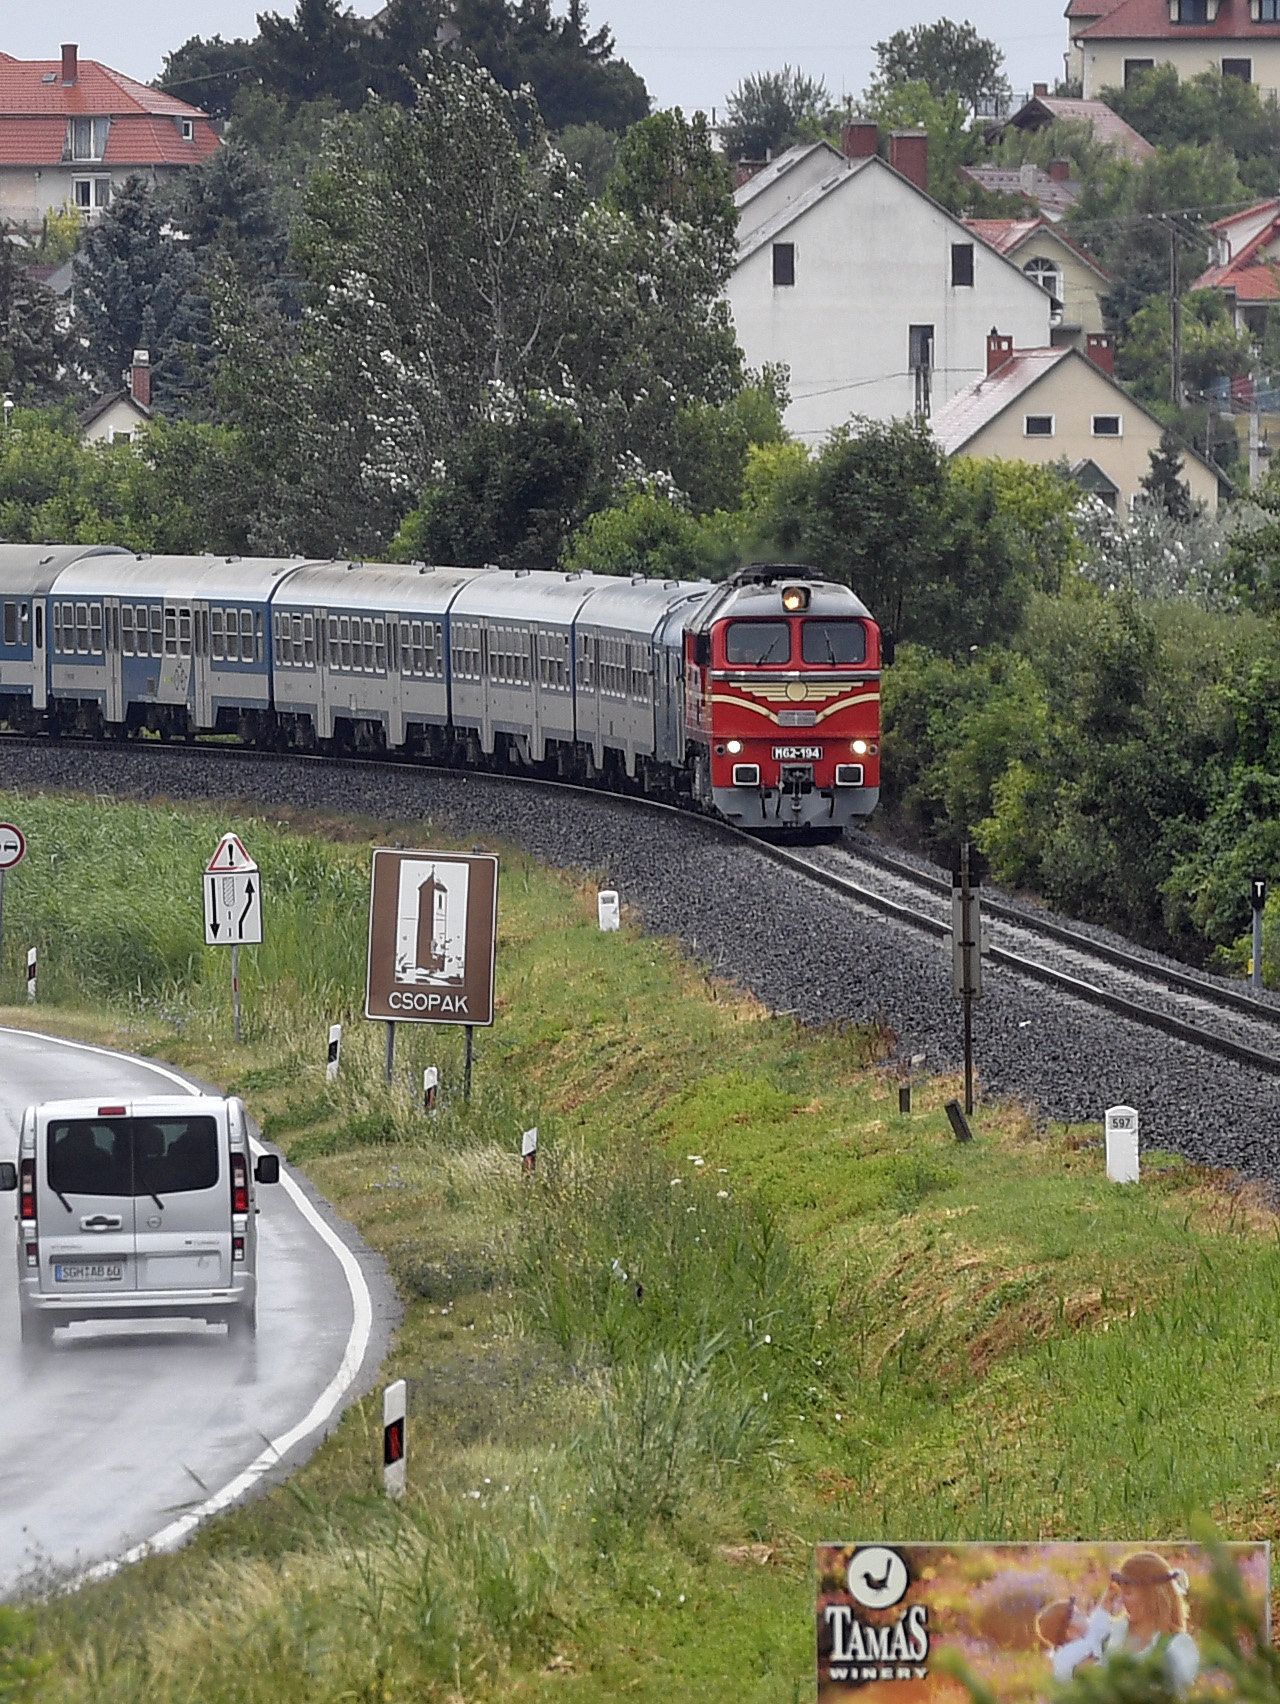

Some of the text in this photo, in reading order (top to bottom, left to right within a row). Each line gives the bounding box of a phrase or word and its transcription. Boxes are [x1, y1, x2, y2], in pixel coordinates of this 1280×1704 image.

[774, 747, 820, 759] M62-194
[388, 991, 469, 1014] CSOPAK
[1112, 1118, 1131, 1129] 597
[824, 1605, 928, 1661] TAMÁS
[830, 1667, 928, 1679] WINERY
